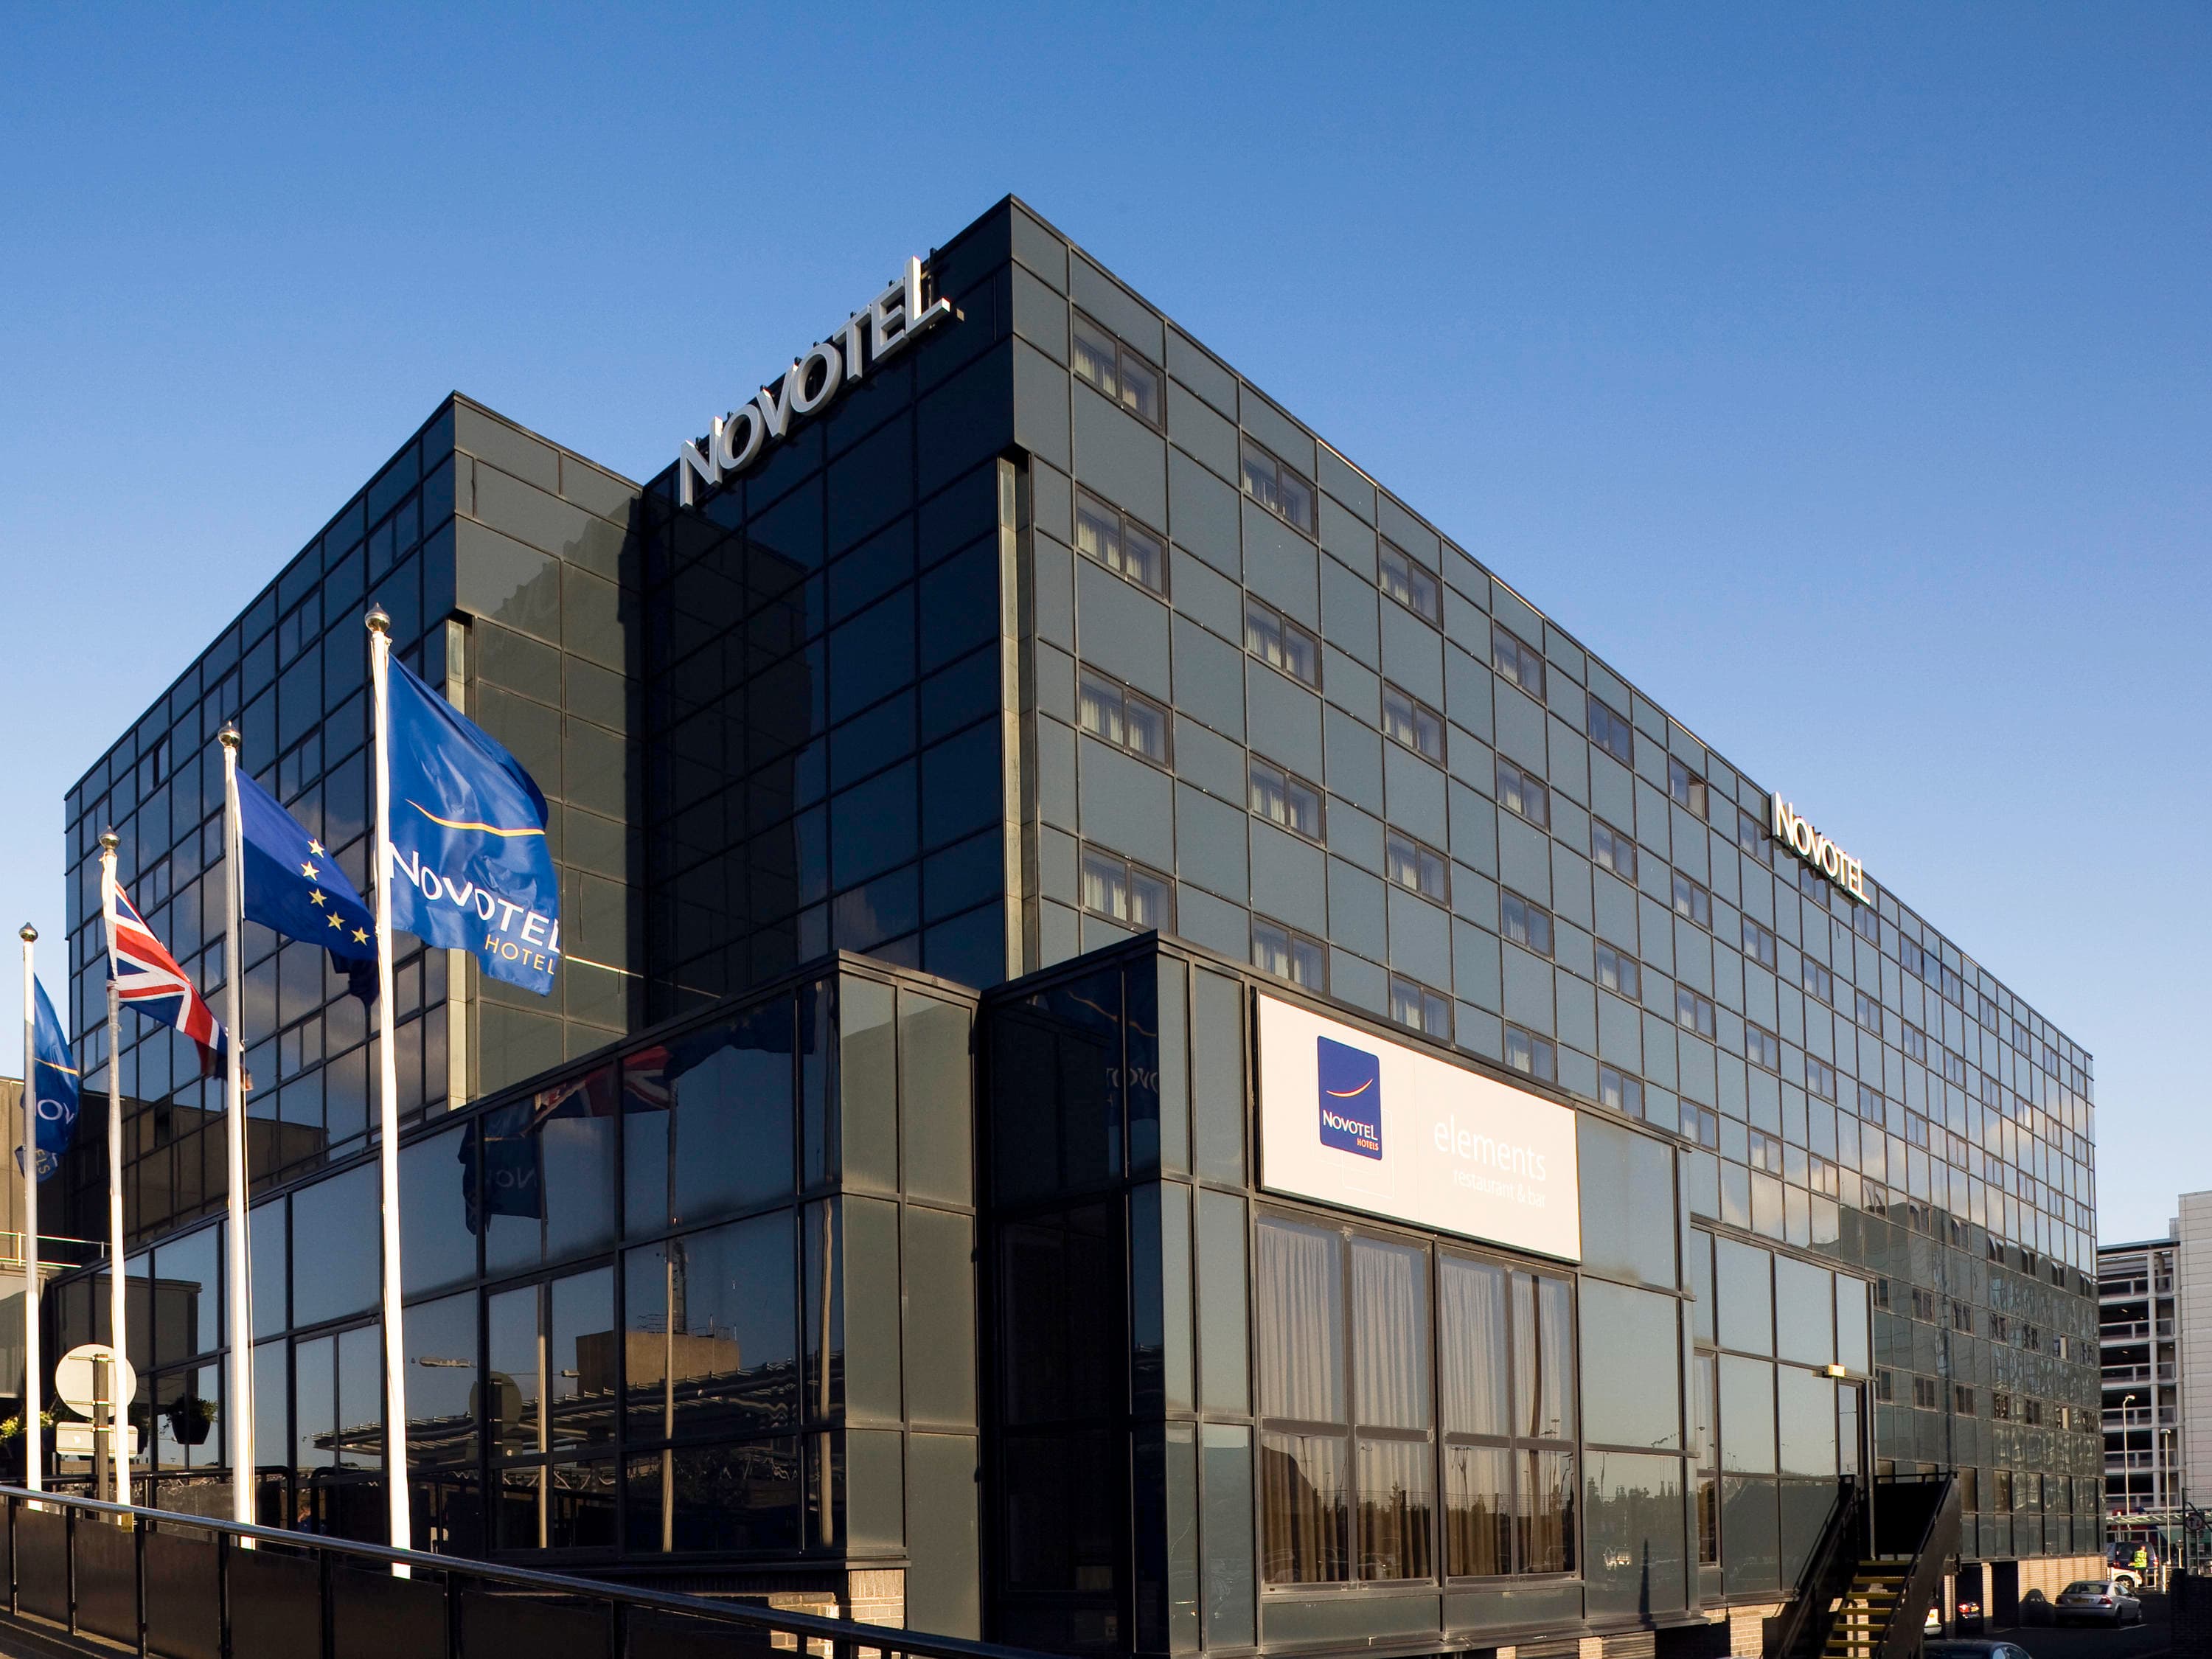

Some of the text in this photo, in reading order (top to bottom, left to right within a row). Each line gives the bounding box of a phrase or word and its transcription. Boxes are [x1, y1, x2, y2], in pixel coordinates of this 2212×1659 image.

[680, 255, 950, 508] NOVOTEL
[1772, 790, 1871, 906] NOVOTEL
[389, 841, 561, 953] NOVOTEL
[34, 1093, 76, 1124] OV
[1322, 1109, 1379, 1141] NOVOTEL
[1357, 1137, 1380, 1152] HOTELS
[1434, 1114, 1546, 1181] elements
[1453, 1168, 1546, 1210] restaurant & bar
